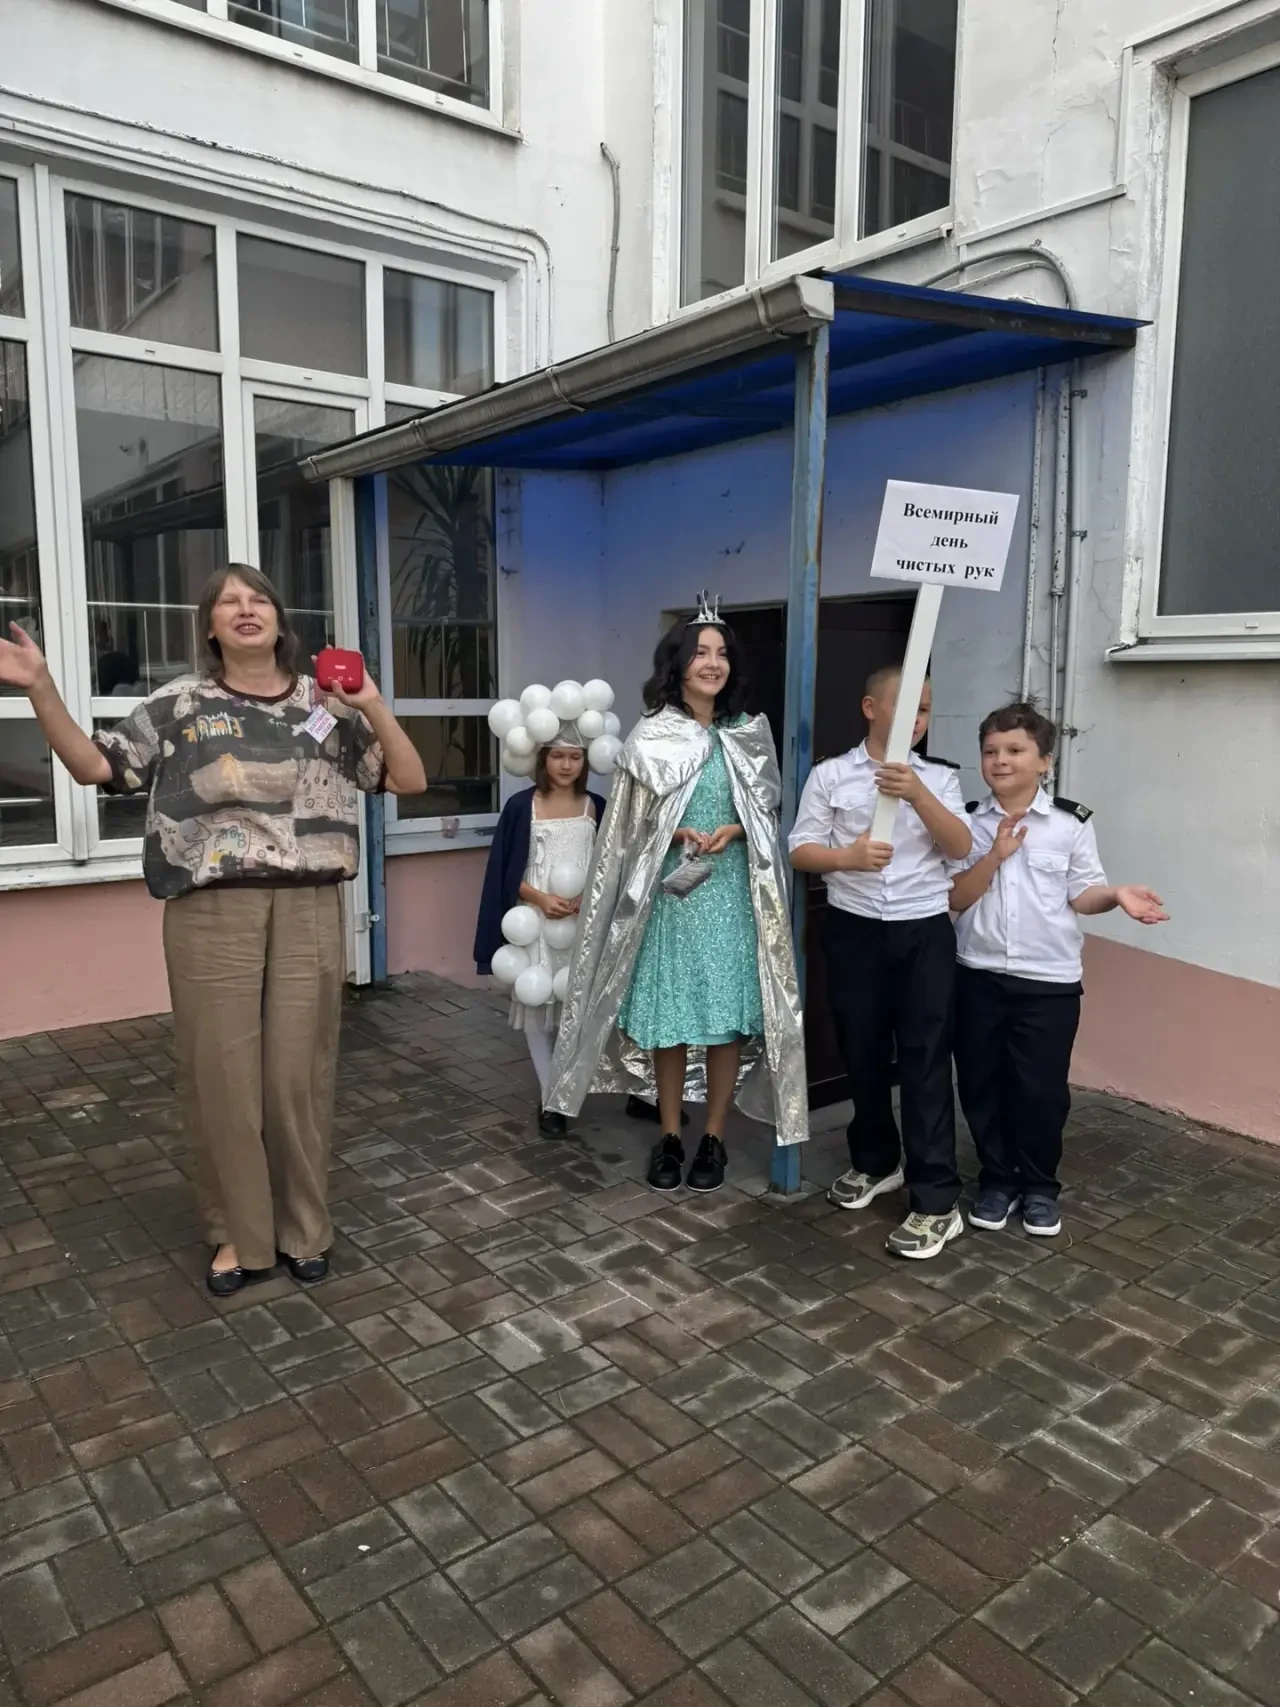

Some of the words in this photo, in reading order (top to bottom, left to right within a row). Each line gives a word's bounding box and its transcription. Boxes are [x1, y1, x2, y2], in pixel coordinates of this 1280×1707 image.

[903, 502, 999, 526] Всемирный
[930, 535, 969, 549] день
[896, 558, 956, 575] чистых
[964, 564, 996, 580] рук
